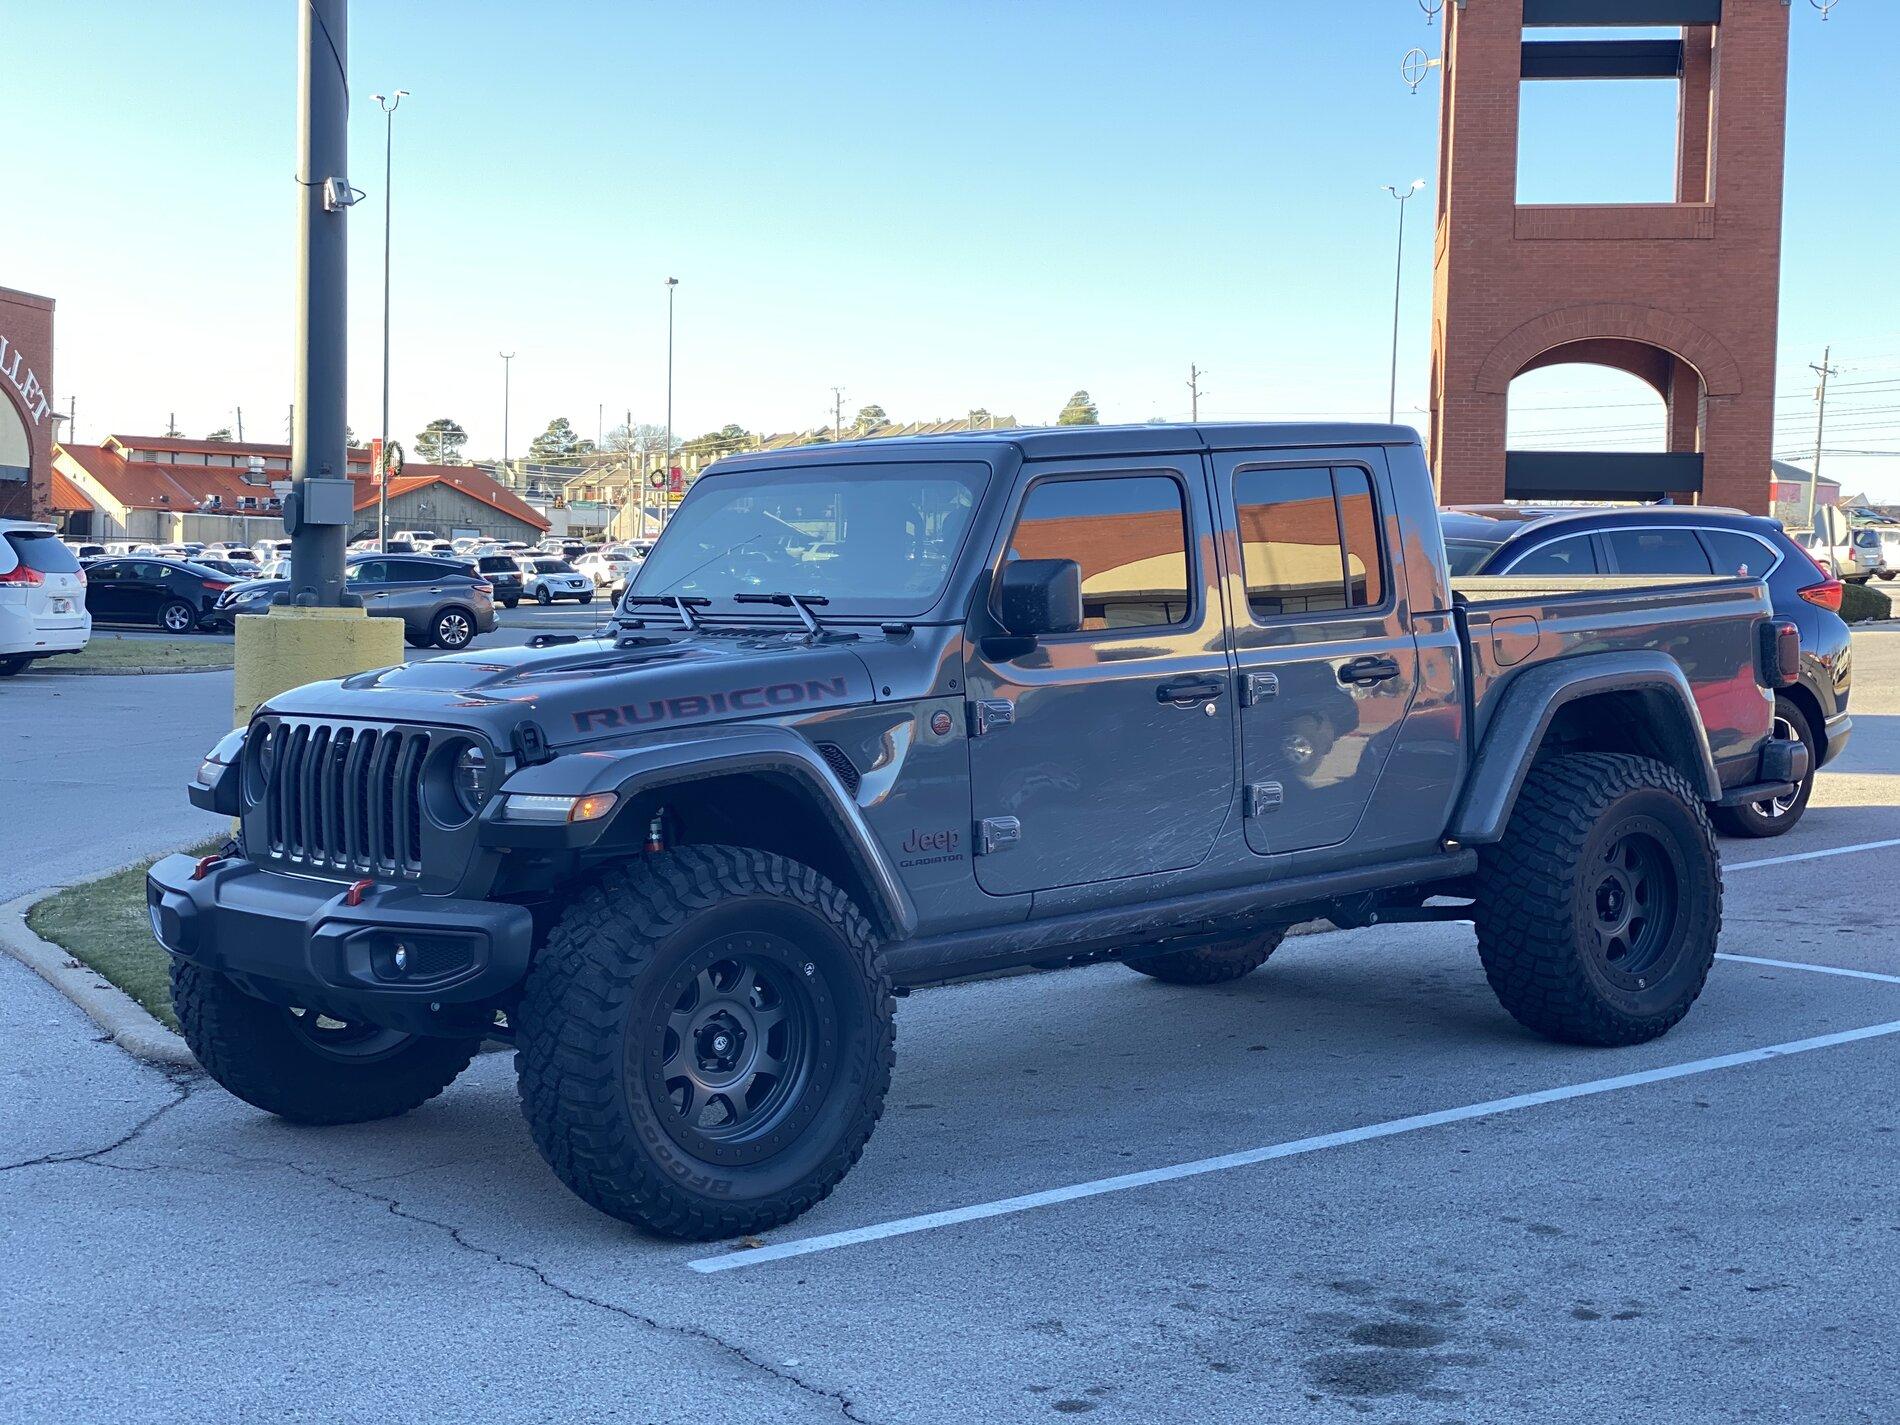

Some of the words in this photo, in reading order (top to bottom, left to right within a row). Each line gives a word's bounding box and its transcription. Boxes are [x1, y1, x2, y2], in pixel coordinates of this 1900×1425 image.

[571, 677, 848, 732] RUBICON
[902, 827, 960, 854] Jeep
[900, 853, 963, 868] GLADIATOR
